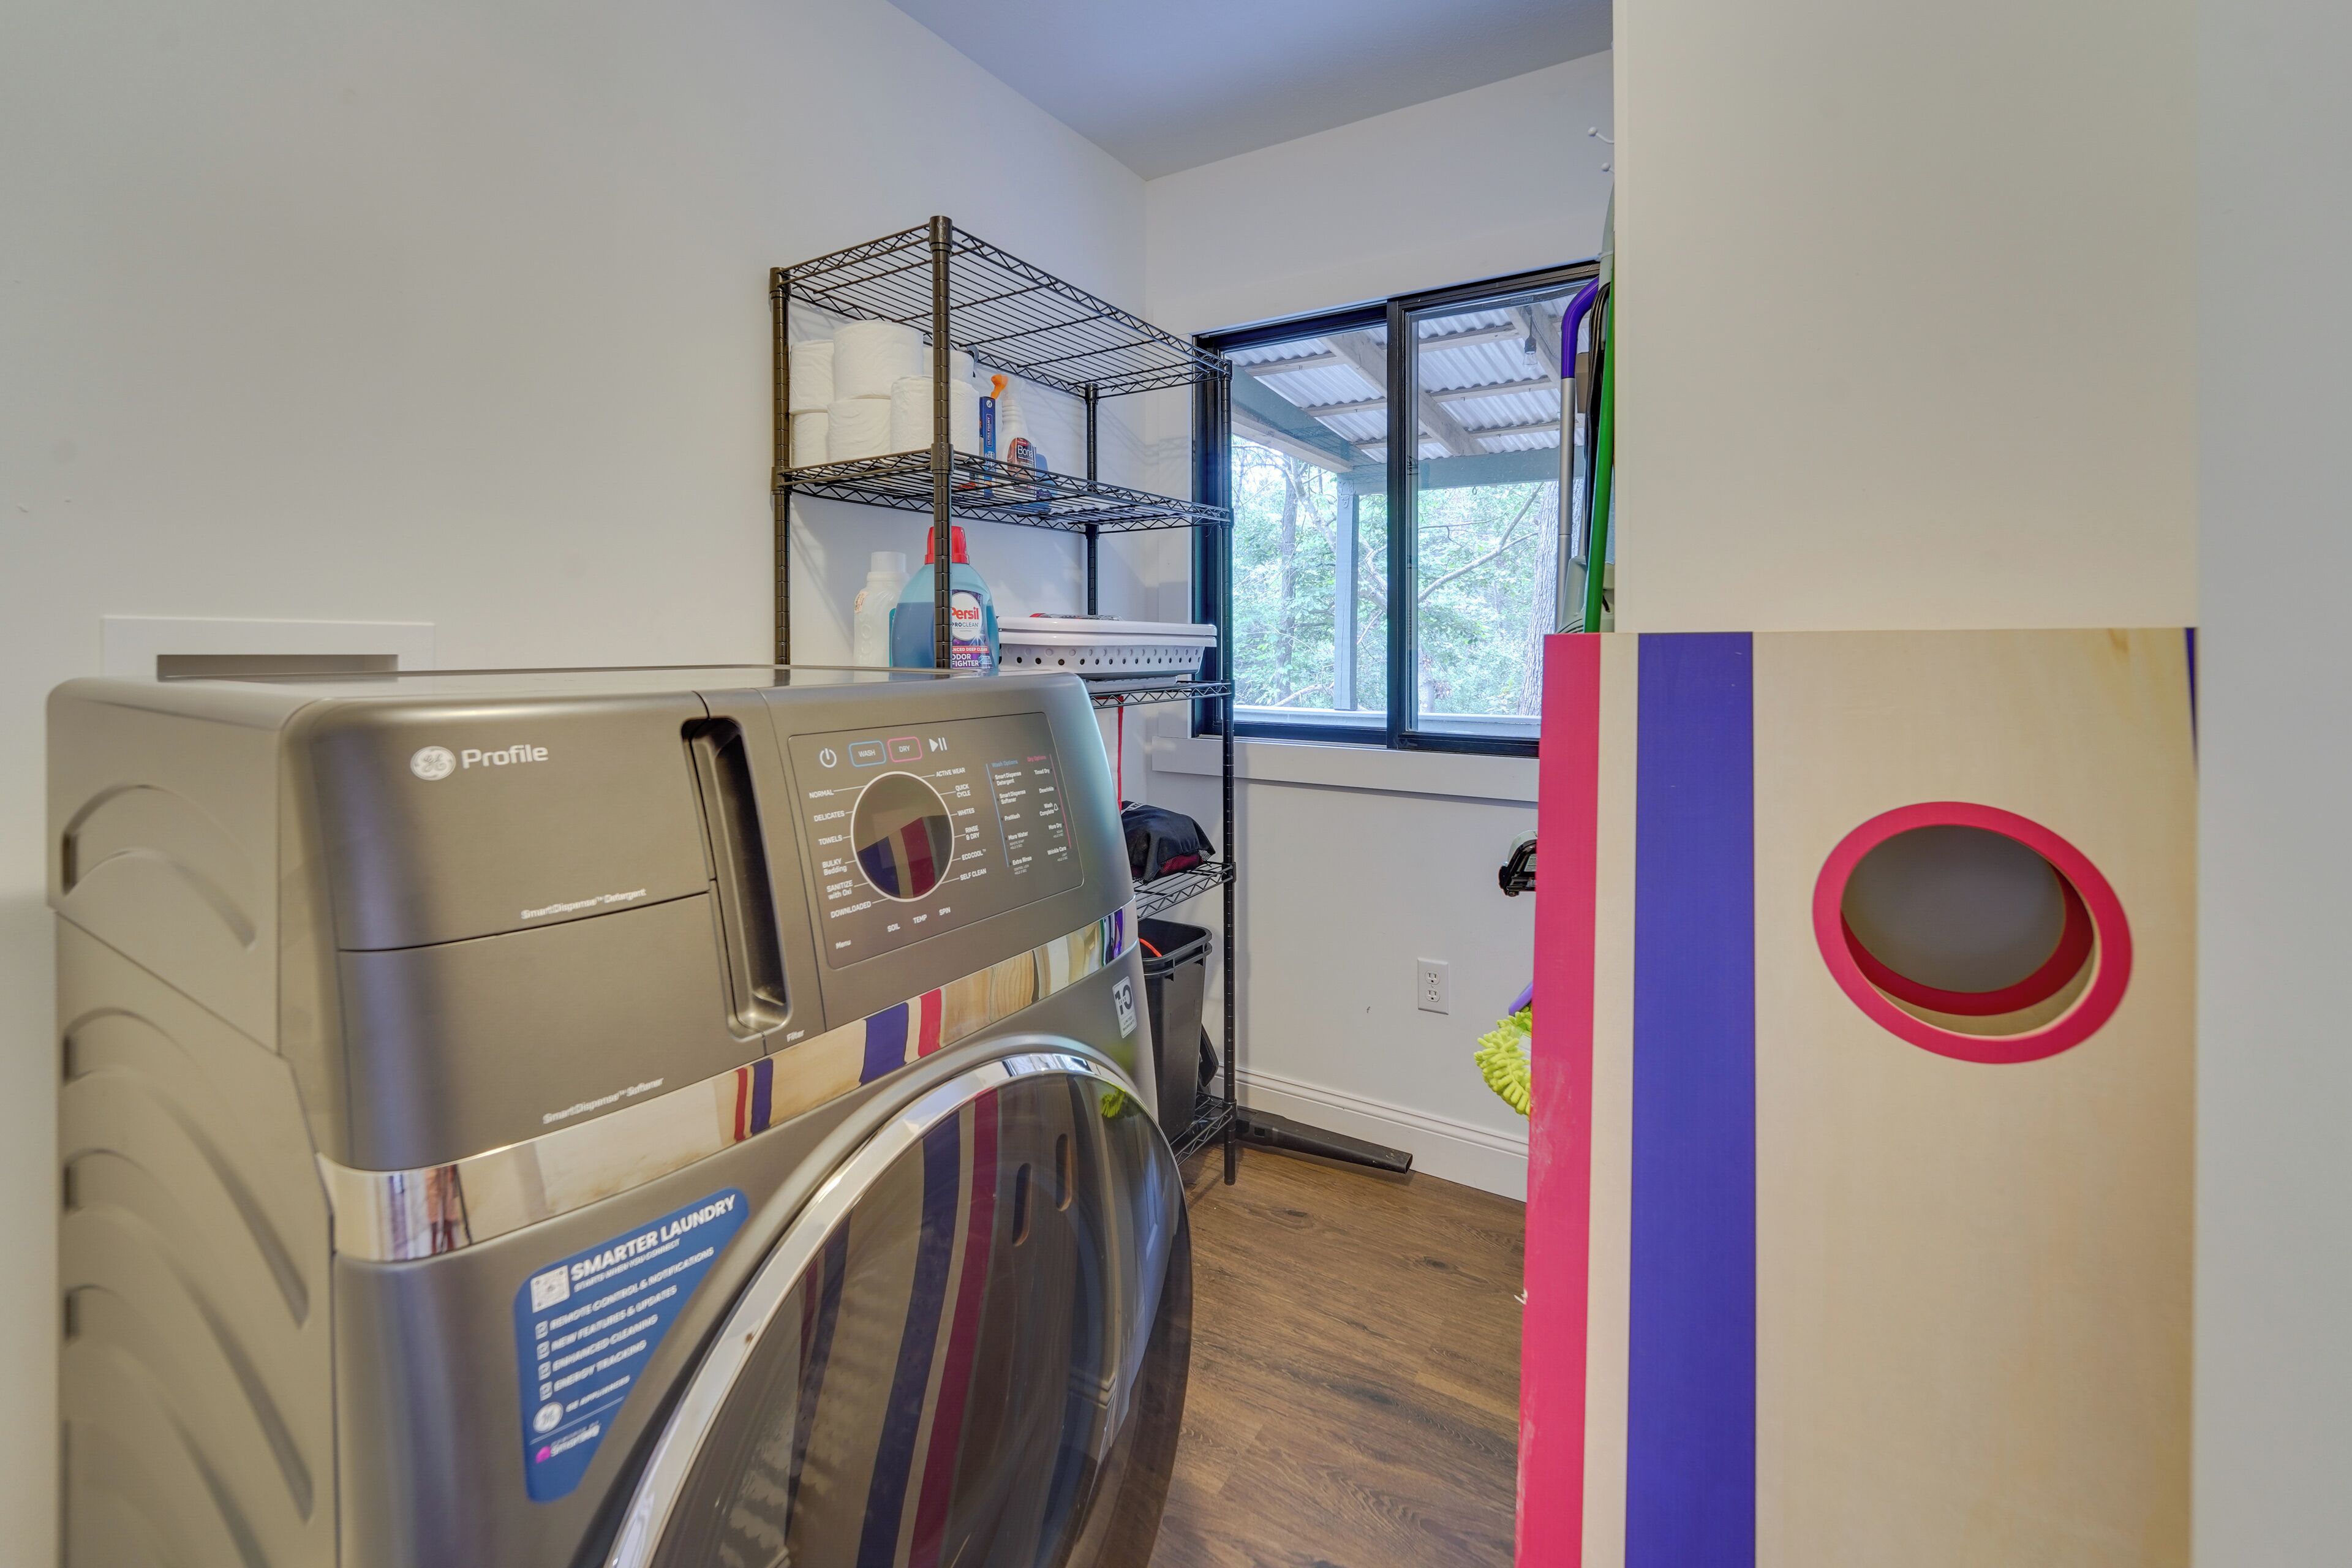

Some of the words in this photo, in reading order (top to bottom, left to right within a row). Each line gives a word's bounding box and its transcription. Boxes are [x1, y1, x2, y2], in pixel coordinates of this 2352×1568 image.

[1017, 445, 1033, 458] Bona
[461, 744, 549, 769] Profile
[936, 769, 952, 777] ACTIVE
[809, 790, 834, 799] NORMAL
[813, 810, 845, 822] DELICATES
[957, 807, 975, 816] WHITES
[965, 825, 979, 834] RINSE
[818, 835, 843, 845] TOWELS
[823, 858, 842, 869] BULKY
[824, 865, 847, 876] Bedding
[960, 872, 971, 881] SELF
[971, 868, 987, 878] CLEAN
[827, 880, 853, 892] SANITIZE
[828, 891, 842, 900] with
[831, 901, 872, 918] DOWNLOADED
[939, 907, 951, 916] SPIN
[913, 914, 927, 924] TEMP
[887, 923, 900, 932] SOIL
[835, 940, 851, 949] Menu
[1115, 984, 1133, 1015] 10
[570, 1231, 659, 1281] SMARTER
[660, 1194, 736, 1243] LAUNDRY
[549, 1303, 592, 1331] REMOTE
[592, 1283, 639, 1311] CONTROL
[639, 1279, 649, 1290] &
[647, 1246, 715, 1286] NOTIFICATIONS
[551, 1332, 578, 1352] NEW
[577, 1310, 627, 1340] FEATURES
